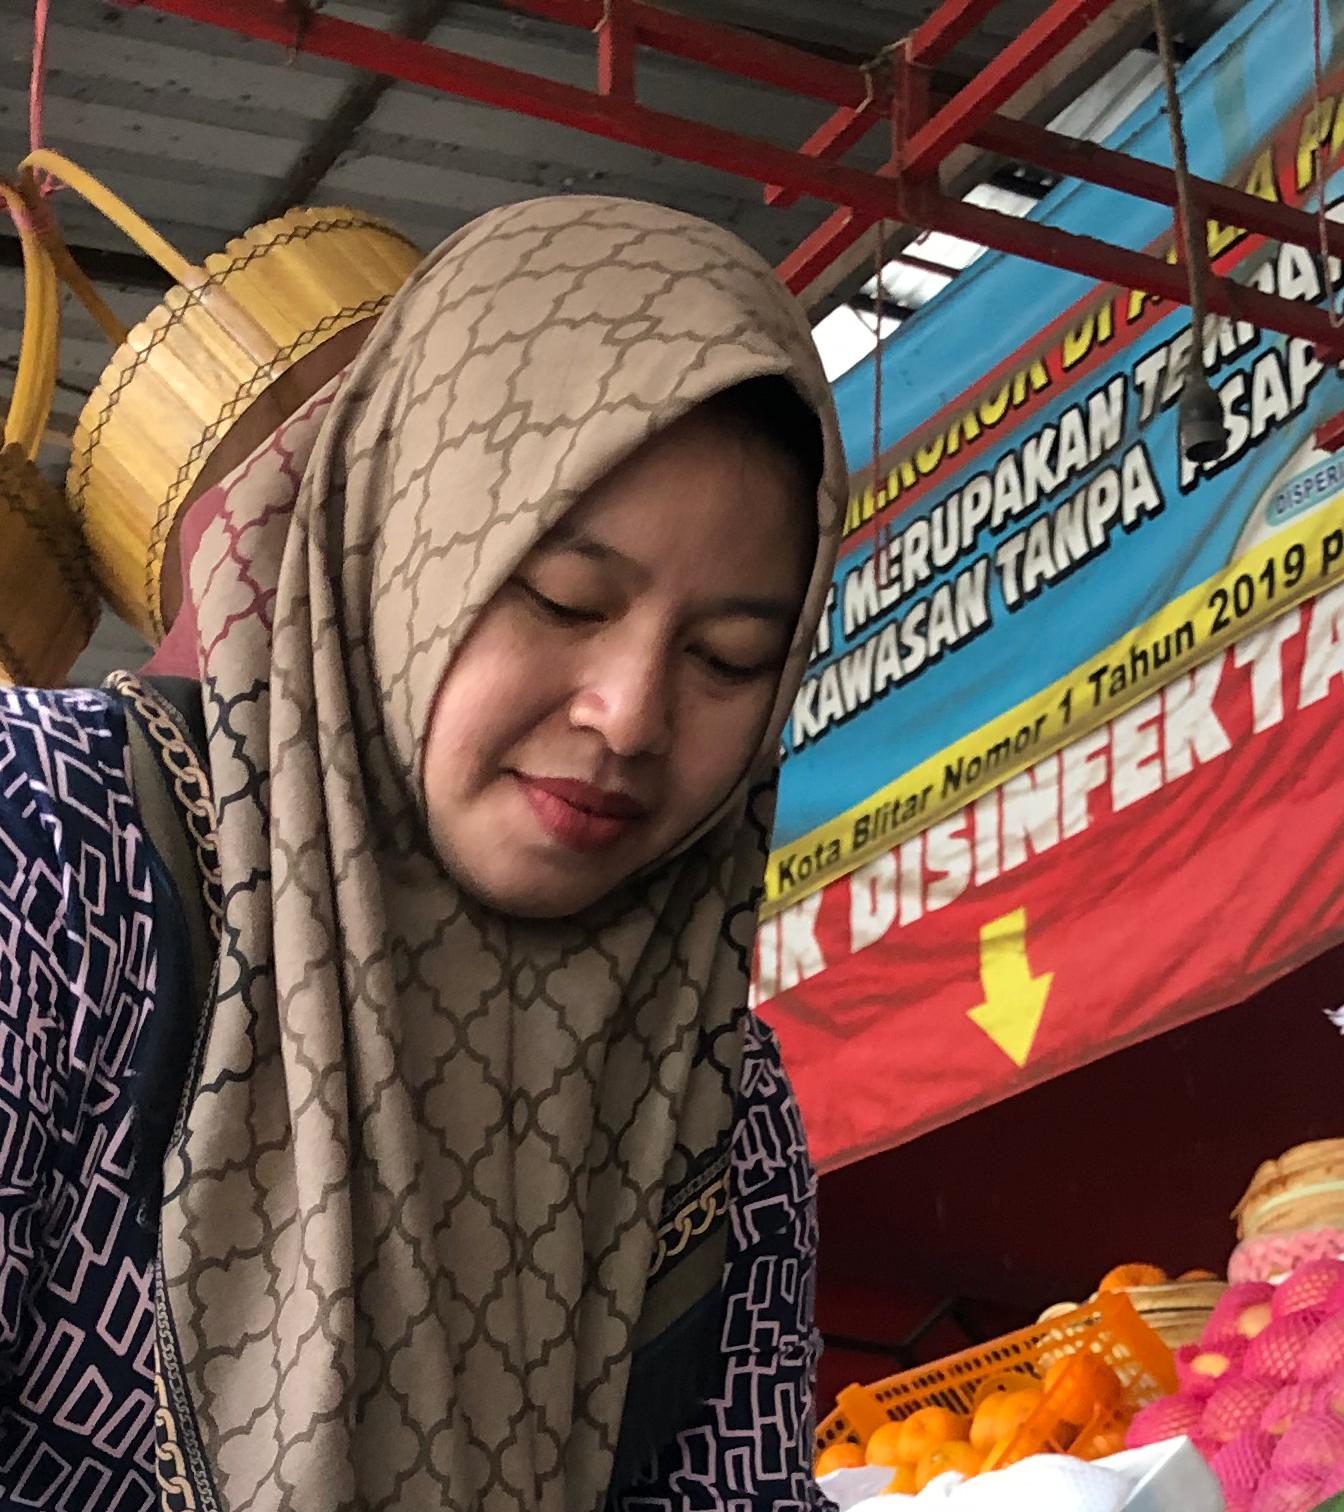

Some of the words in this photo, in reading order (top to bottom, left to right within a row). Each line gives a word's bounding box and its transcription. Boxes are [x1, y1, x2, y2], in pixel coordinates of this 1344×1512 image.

[789, 554, 993, 752] KAWASAN
[996, 440, 1163, 613] TANPA
[1180, 336, 1326, 492] SAP
[843, 375, 1127, 642] MERUPAKAN
[777, 837, 842, 894] Kota
[851, 783, 933, 850] Blitar
[941, 713, 1048, 801] Nomor
[1057, 686, 1074, 728] 1
[1088, 620, 1195, 706] Tahun
[1208, 543, 1306, 637] 2019
[748, 889, 828, 1011] IK
